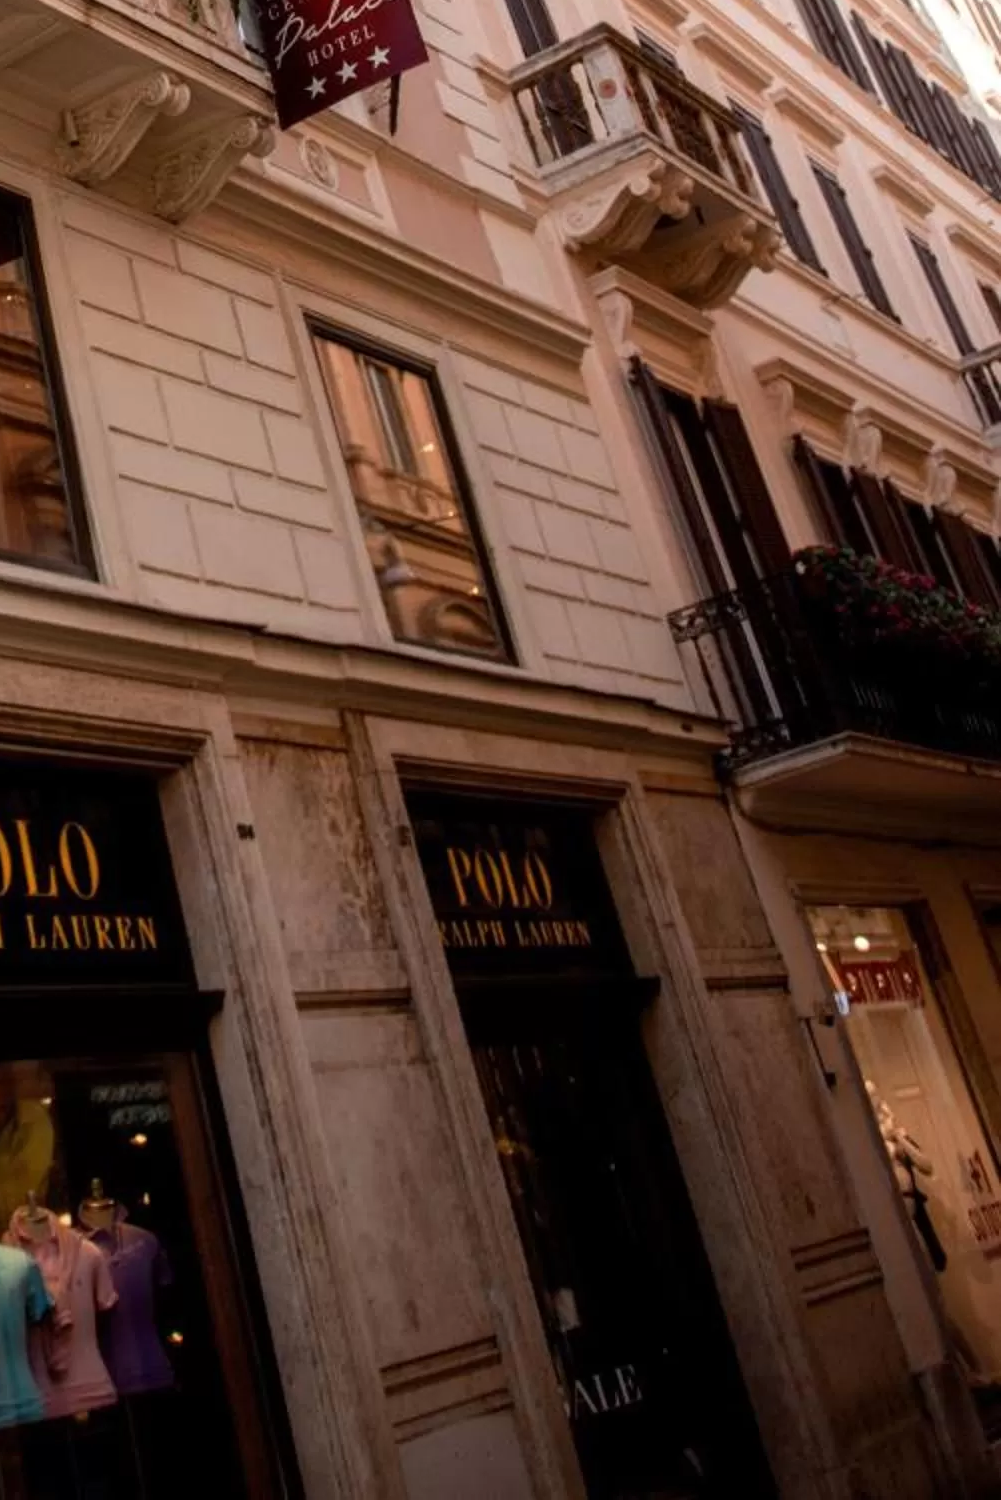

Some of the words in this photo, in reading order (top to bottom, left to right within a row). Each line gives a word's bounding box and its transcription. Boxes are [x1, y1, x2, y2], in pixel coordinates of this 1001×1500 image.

[307, 25, 375, 67] HOTEL
[447, 847, 552, 908] POLO
[25, 913, 158, 950] LAUREN
[514, 920, 592, 947] LAUREN
